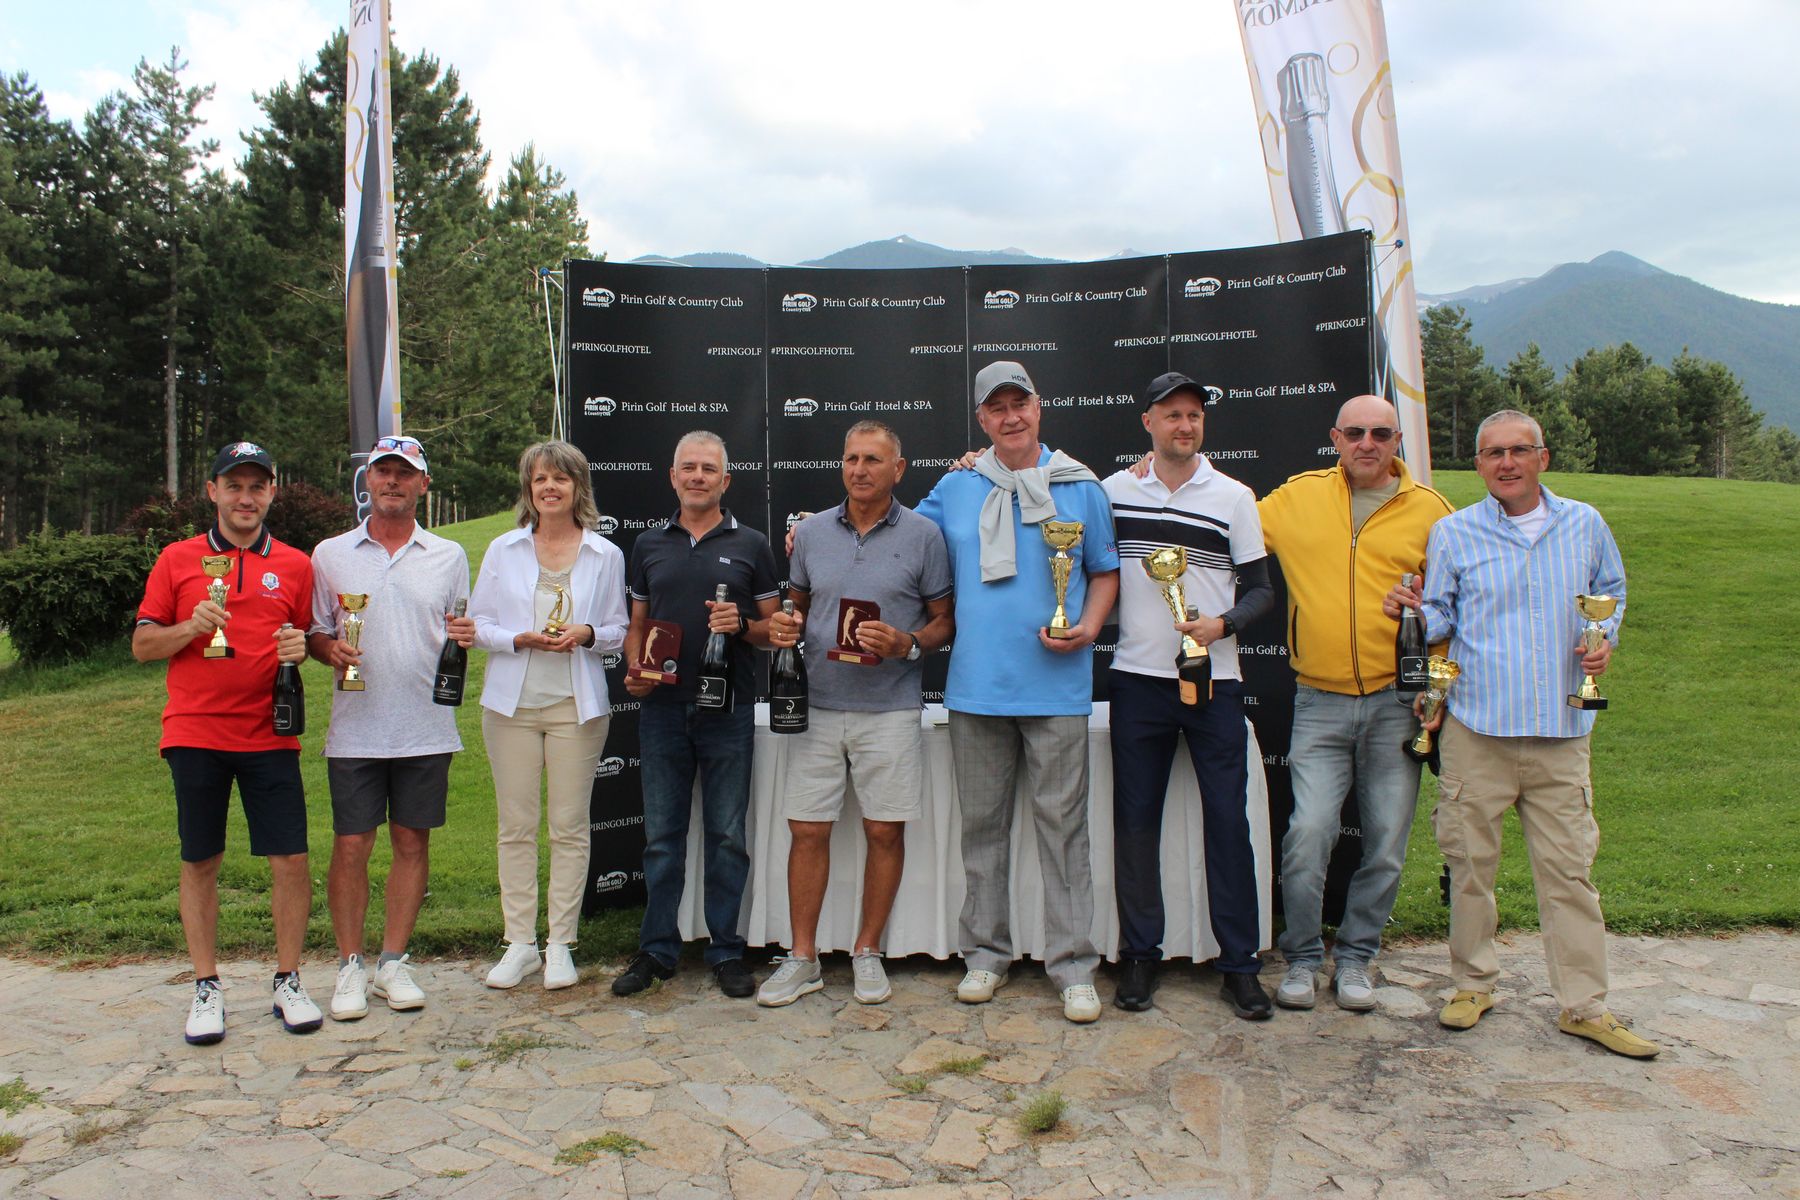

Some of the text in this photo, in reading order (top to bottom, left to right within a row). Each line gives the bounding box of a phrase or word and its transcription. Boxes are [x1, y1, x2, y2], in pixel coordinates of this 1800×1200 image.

[1228, 265, 1346, 289] Pirin Golf & Country Club
[1026, 286, 1147, 303] Pirin Golf & Country Club
[621, 294, 743, 309] Pirin Golf & Country Club
[823, 296, 945, 309] Pirin Golf & Country Club
[1316, 318, 1366, 331] #PIRINGOLF
[1171, 330, 1257, 342] #PIRINGOLFHOTEL
[1114, 336, 1166, 347] #PIRINGOLF
[572, 342, 651, 354] #PIRINGOLFHOTEL
[771, 347, 854, 355] #PIRINGOLFHOTEL
[910, 345, 963, 354] #PIRINGOLF
[973, 343, 1057, 351] #PIRINGOLFHOTEL
[1229, 382, 1336, 398] Pirin Golf Hotel & SPA
[1053, 397, 1074, 406] Golf
[1079, 396, 1103, 405] Hotel
[1106, 396, 1114, 404] &
[1116, 395, 1134, 404] SPA
[622, 402, 728, 412] Pirin Golf Hotel & SPA
[825, 401, 932, 411] Pirin Golf Hotel & SPA
[912, 458, 957, 467] #PIRINGO
[1115, 454, 1144, 462] #PIRIN
[588, 462, 652, 470] RINGOLFHOTEL
[728, 462, 763, 470] INGOLF
[623, 518, 668, 529] Pirin Golf
[1237, 645, 1287, 655] irin Golf &
[629, 758, 641, 767] Pir
[1264, 755, 1277, 765] olf
[633, 871, 644, 880] Pir
